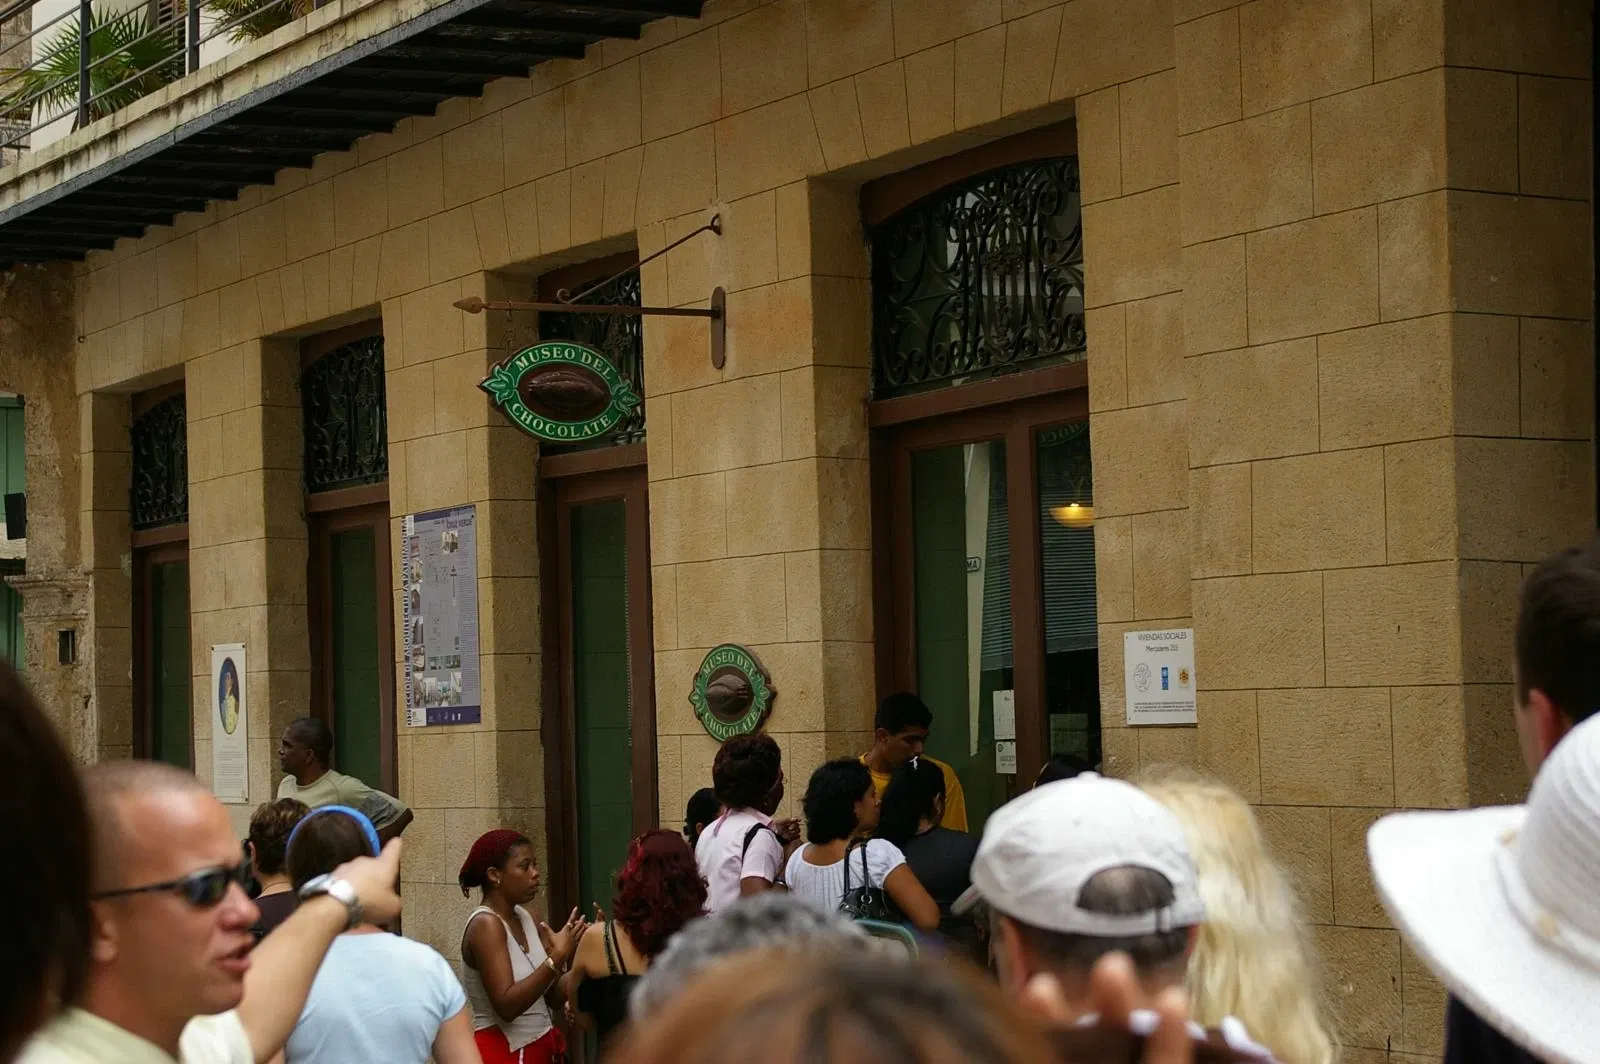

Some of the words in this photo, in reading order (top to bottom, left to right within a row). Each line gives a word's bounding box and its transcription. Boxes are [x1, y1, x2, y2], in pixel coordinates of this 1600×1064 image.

[514, 347, 575, 371] MUSEO
[581, 353, 612, 380] DEL
[512, 403, 612, 438] CHOCOLATE
[1163, 631, 1187, 640] SOCIALES
[703, 651, 735, 677] MUSEO
[737, 655, 756, 680] DEL
[704, 710, 759, 738] CHOCOLATE
